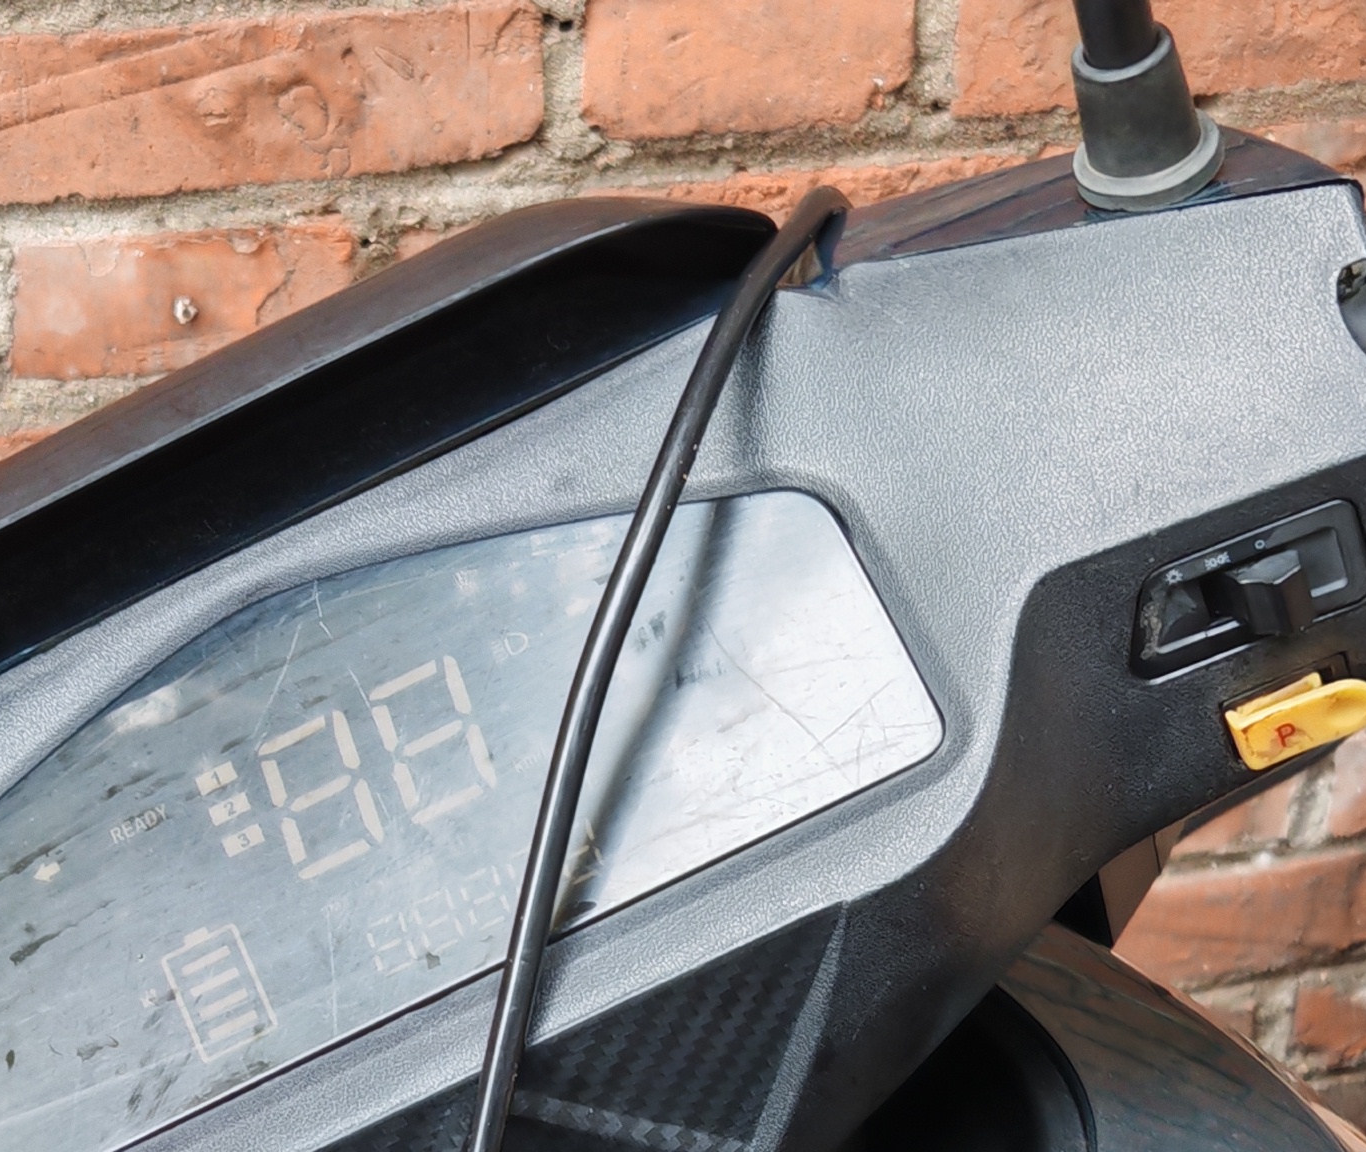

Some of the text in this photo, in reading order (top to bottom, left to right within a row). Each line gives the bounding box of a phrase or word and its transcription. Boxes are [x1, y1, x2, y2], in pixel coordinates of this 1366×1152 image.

[1275, 722, 1297, 748] P
[222, 801, 238, 817] 2
[109, 803, 168, 845] READY
[236, 832, 251, 848] 3
